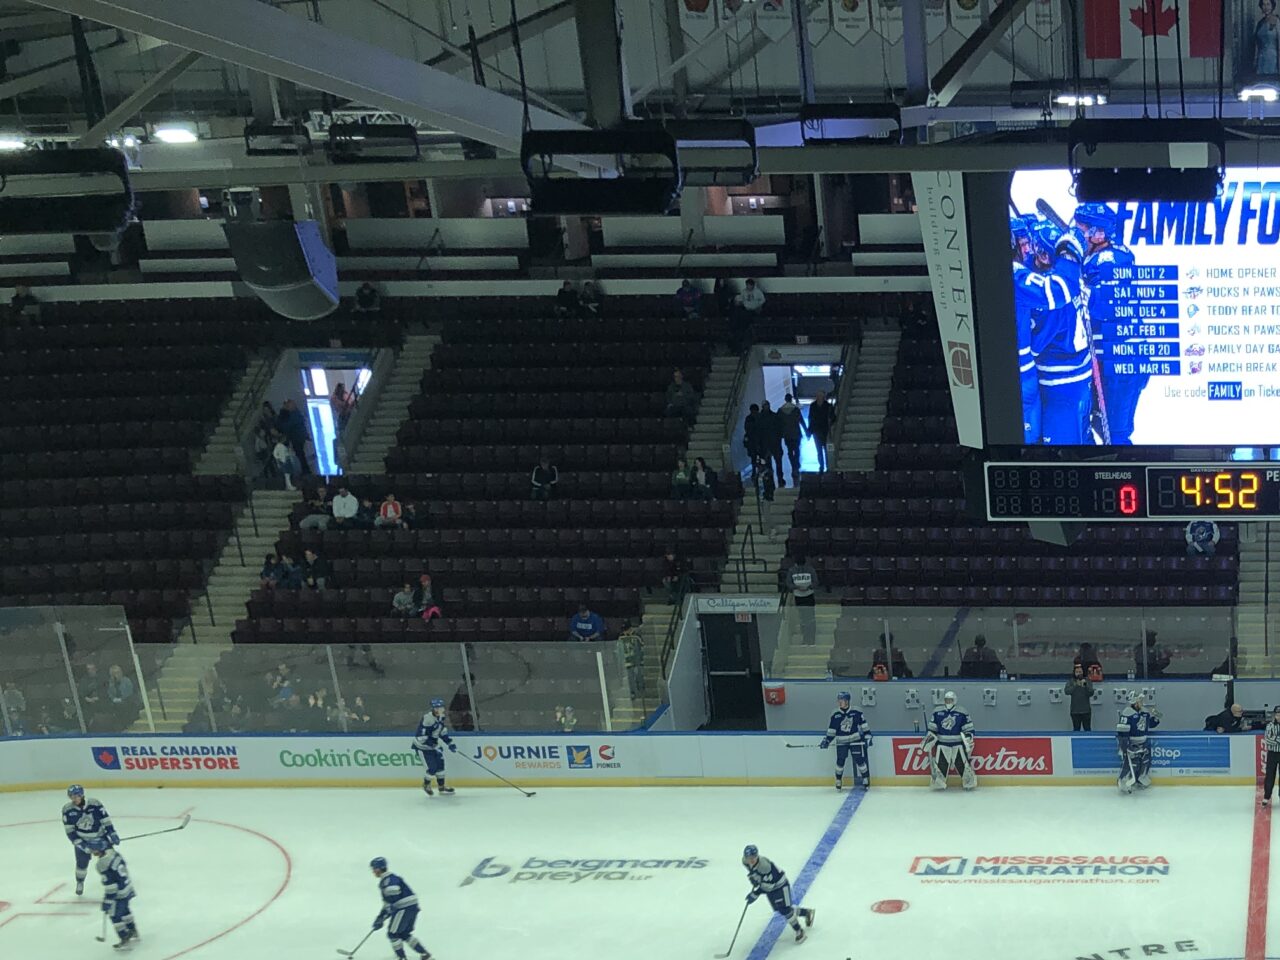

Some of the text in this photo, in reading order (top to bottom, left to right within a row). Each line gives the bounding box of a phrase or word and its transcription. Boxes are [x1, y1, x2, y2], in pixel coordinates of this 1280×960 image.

[1114, 181, 1239, 245] FAMILY
[936, 171, 971, 332] CONTEK
[1158, 267, 1165, 279] 2
[1206, 267, 1277, 278] HOME OPENER
[1158, 287, 1165, 298] 5
[1206, 287, 1239, 297] PUCKS
[1242, 286, 1250, 297] N
[1114, 305, 1166, 317] SUN. DEC 4
[1207, 305, 1237, 316] TEDDY
[1241, 305, 1267, 316] BEAR
[1116, 325, 1165, 336] SAT. FEB 11
[1207, 325, 1240, 335] PUCKS
[1243, 325, 1250, 335] N
[1112, 344, 1171, 356] MON. FEB 20
[1208, 343, 1242, 354] FAMILY
[1245, 343, 1265, 354] DAY
[1113, 363, 1171, 375] WED. MAR 15
[1208, 362, 1278, 373] MARCH BREAK
[1164, 386, 1182, 398] Use
[1184, 385, 1206, 398] code
[1207, 383, 1242, 399] FAMILY
[1243, 388, 1256, 398] on
[1094, 471, 1132, 480] STEELHEADS
[1181, 473, 1258, 509] 4:52
[1119, 486, 1137, 514] 0
[121, 745, 237, 756] REAL CANADIAN
[124, 756, 240, 770] SUPERSTORE
[971, 746, 1046, 771] ortons
[515, 761, 562, 769] REWARDS
[521, 857, 710, 871] bergmanis
[974, 856, 1170, 865] MISSISSAUGA
[971, 865, 1170, 876] MARATHON
